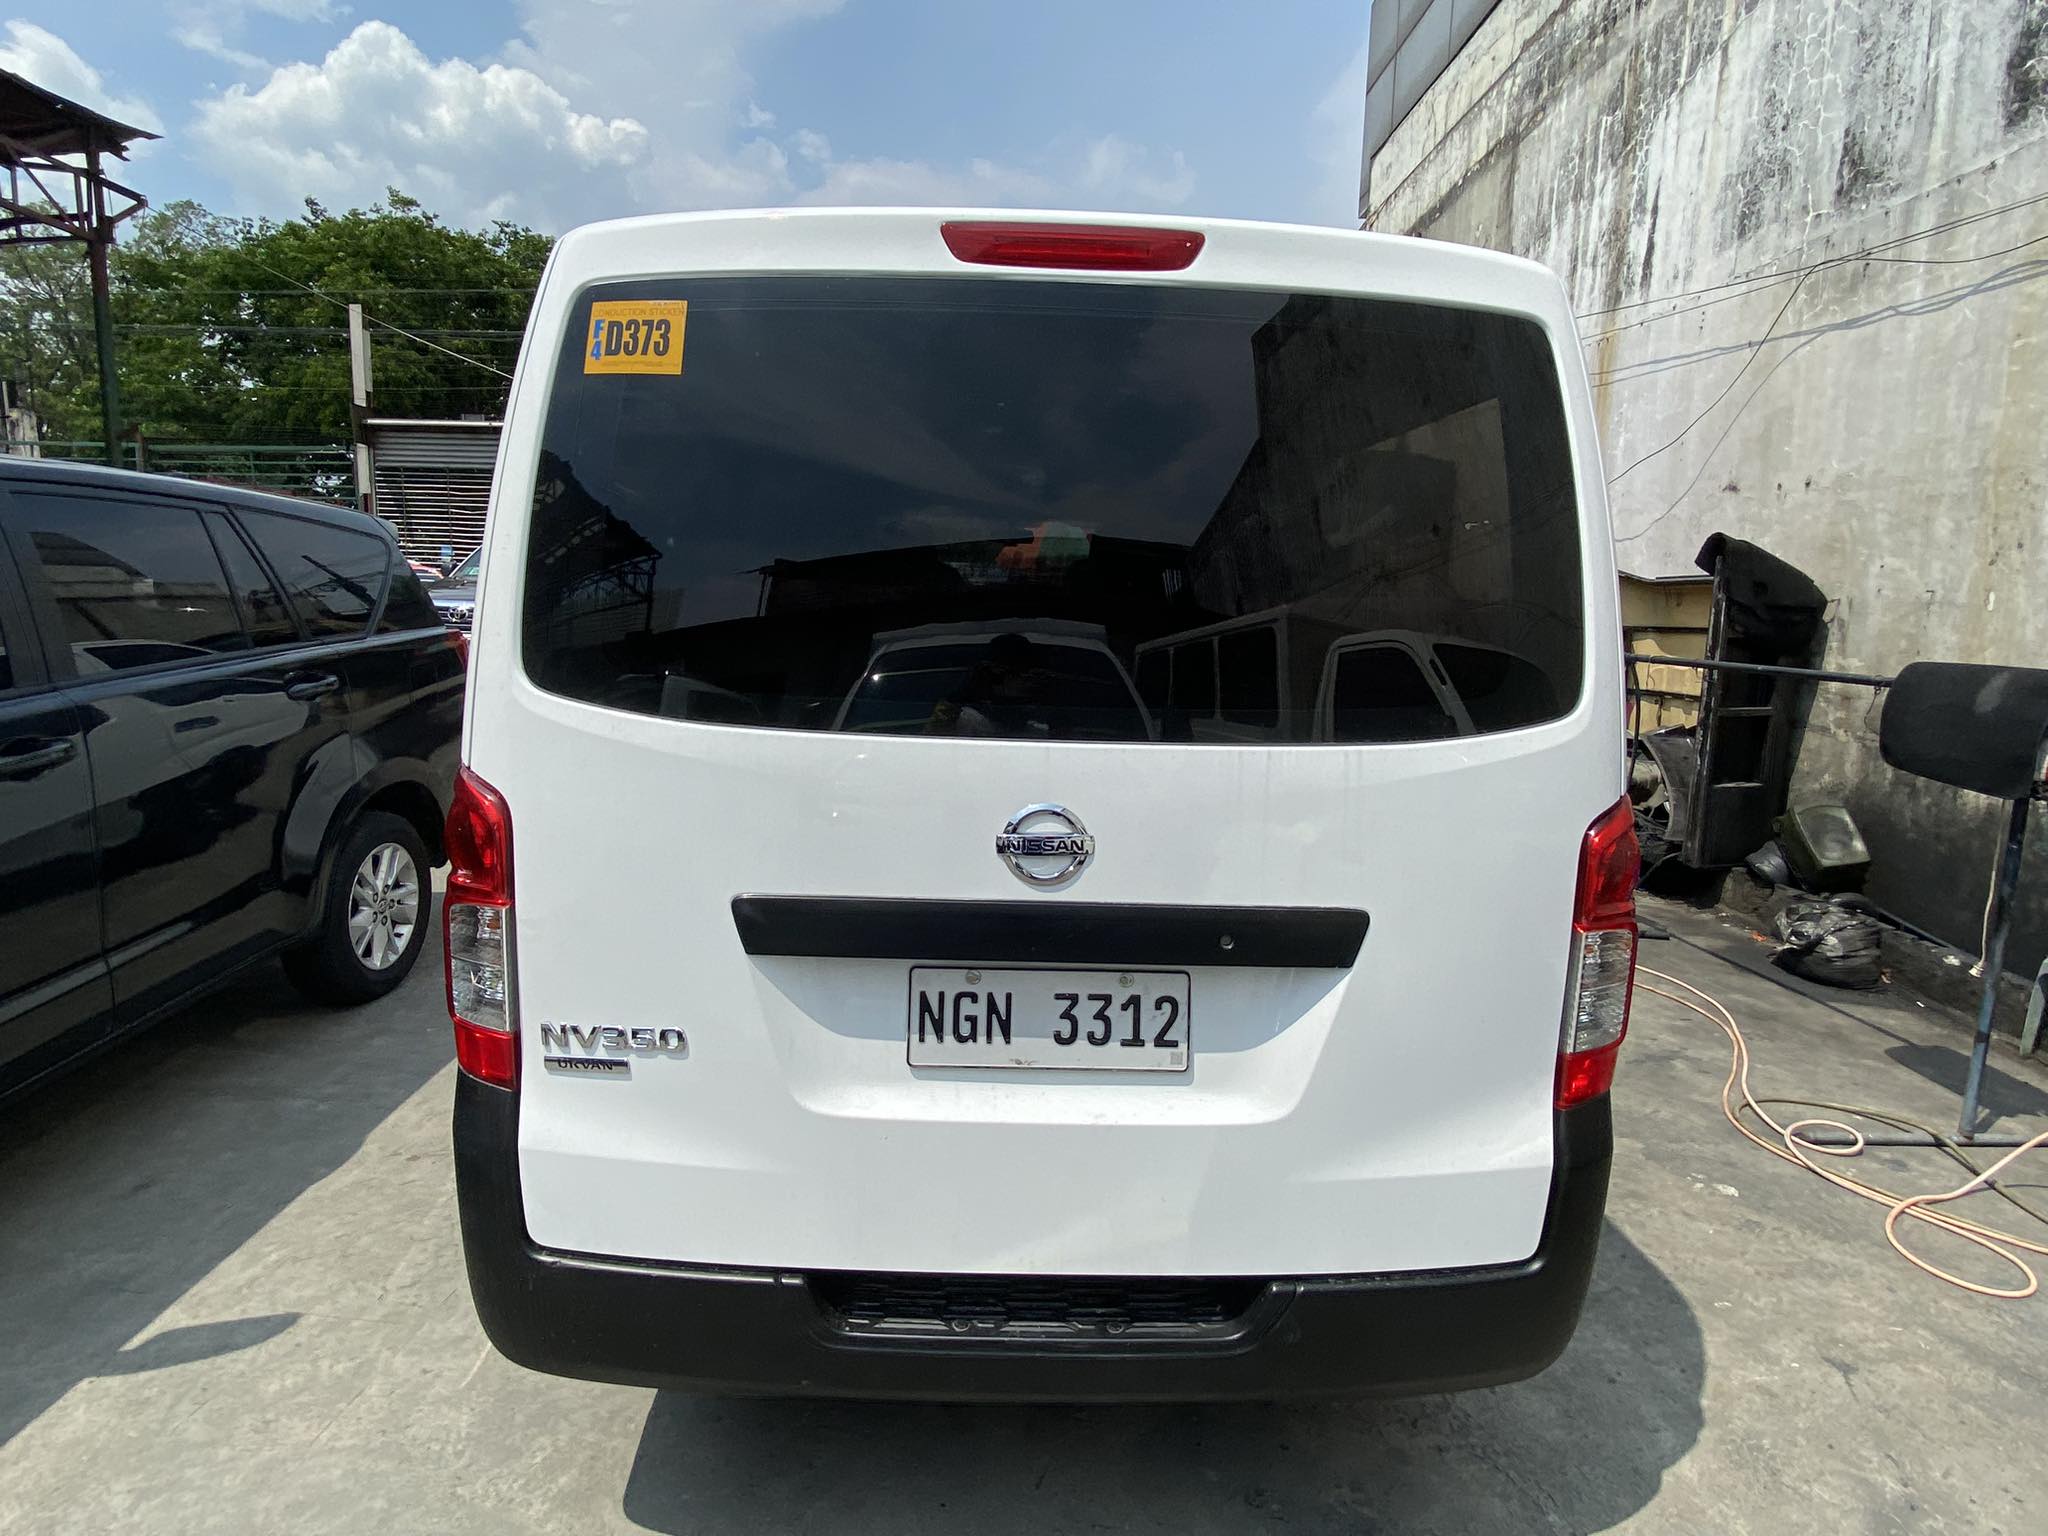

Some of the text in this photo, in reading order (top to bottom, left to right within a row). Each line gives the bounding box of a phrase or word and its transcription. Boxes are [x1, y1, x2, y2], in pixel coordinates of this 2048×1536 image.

[605, 318, 671, 357] D373
[1004, 838, 1085, 853] NISSAN
[918, 990, 1180, 1048] NGN 3312
[540, 1021, 688, 1053] NV350
[557, 1057, 614, 1071] URVAN
